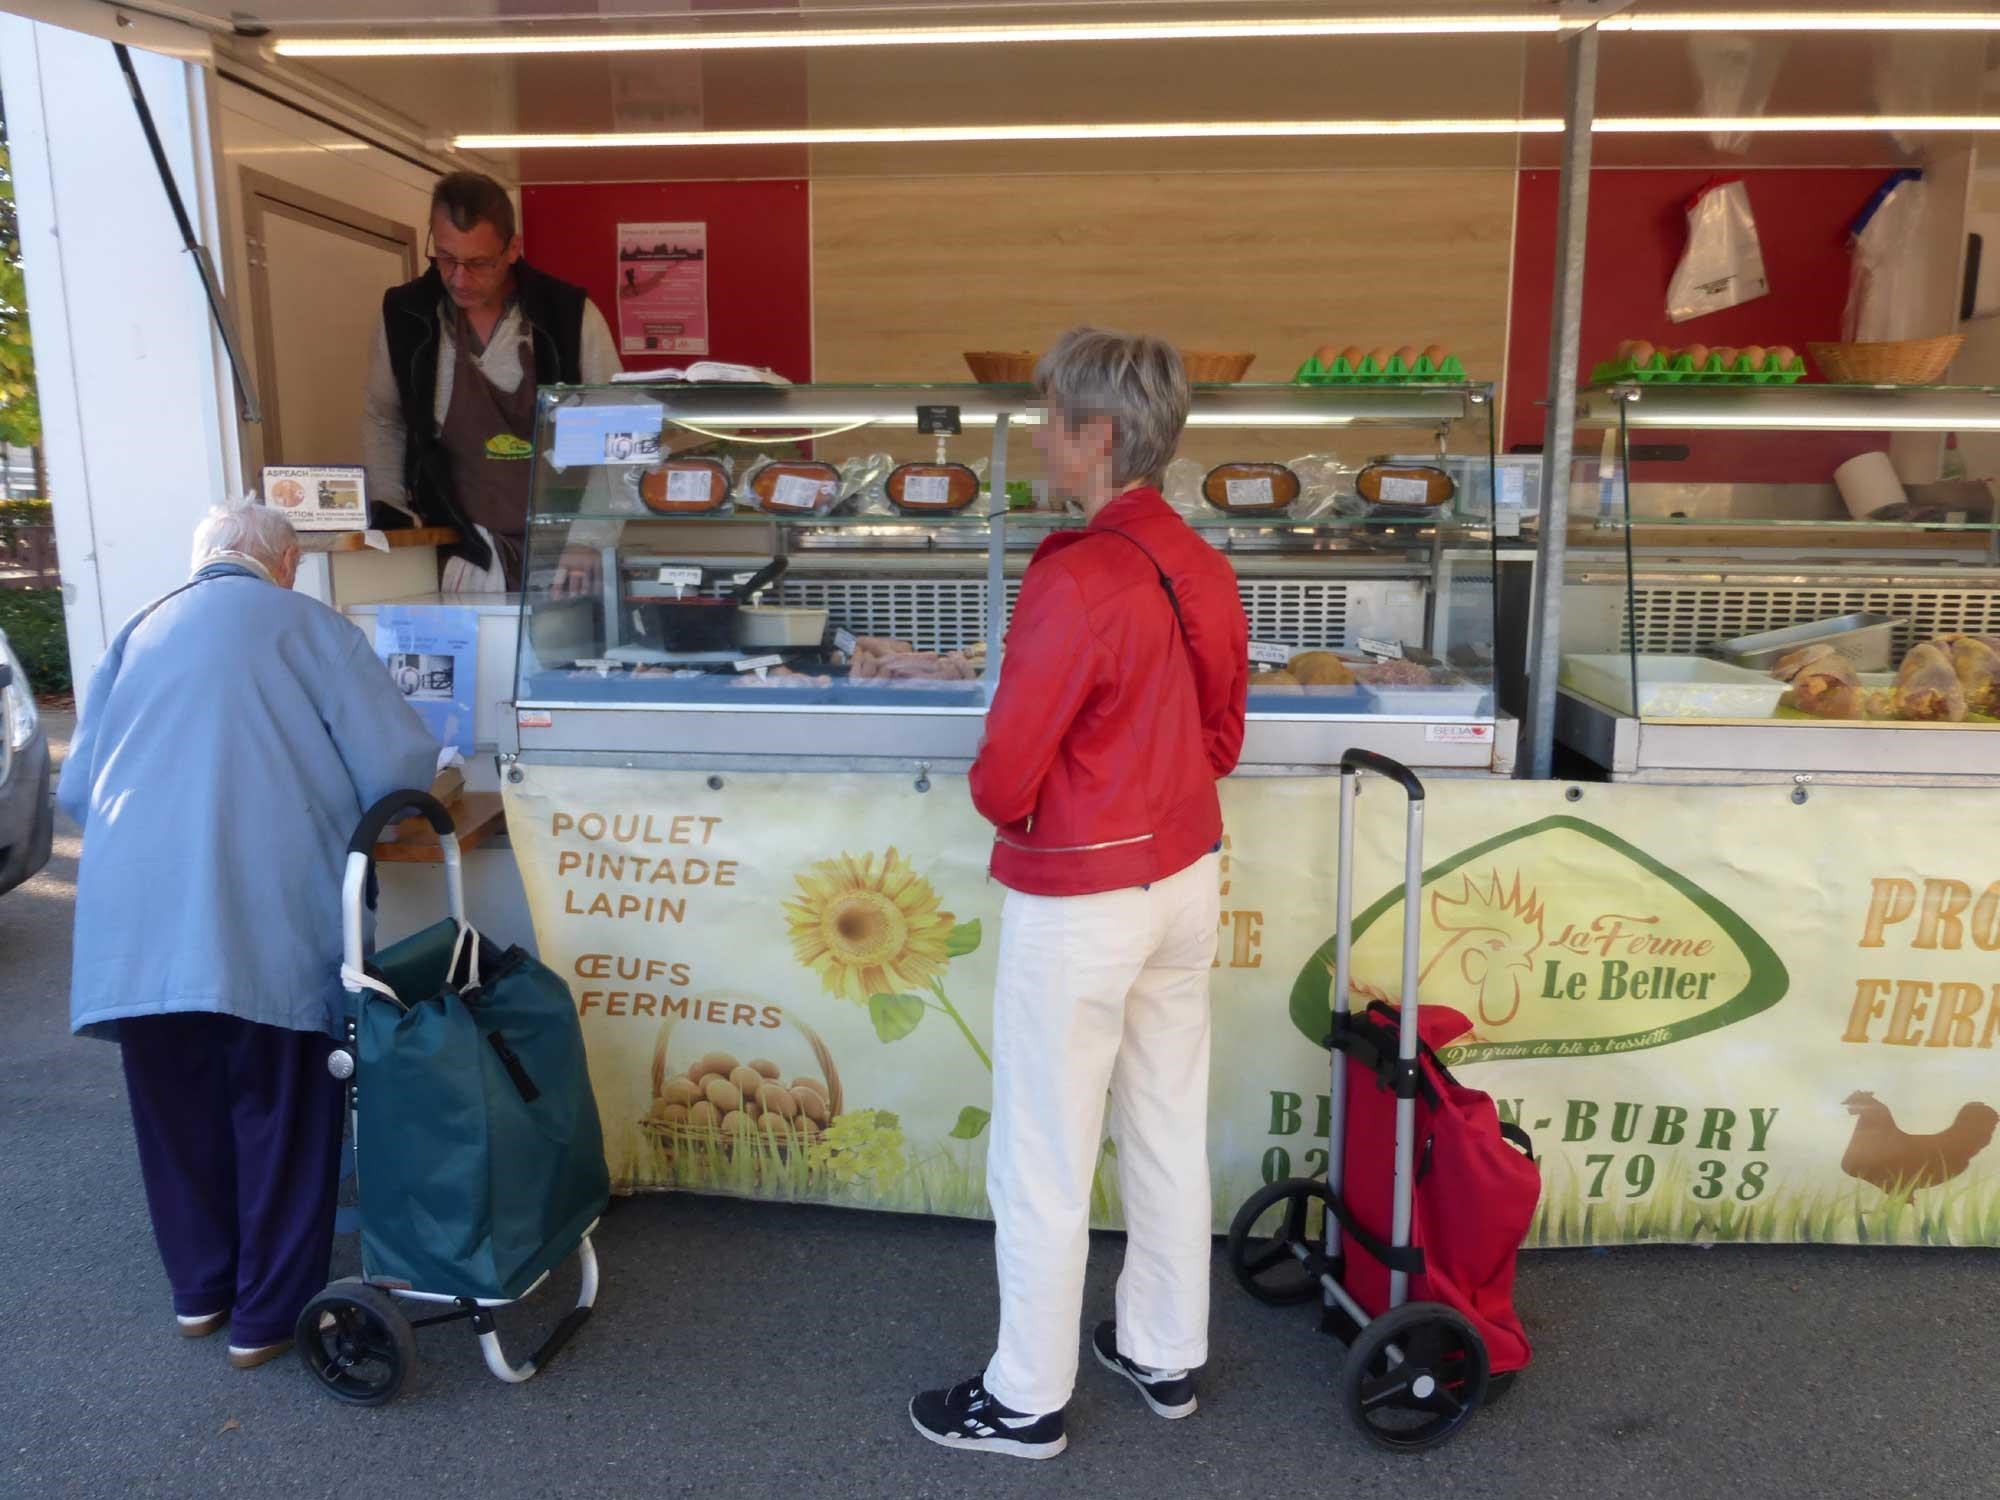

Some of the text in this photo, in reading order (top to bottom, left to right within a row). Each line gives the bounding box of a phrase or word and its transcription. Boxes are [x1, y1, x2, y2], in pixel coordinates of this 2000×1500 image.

[552, 812, 722, 845] POULET
[558, 851, 738, 886] PINTADE
[565, 889, 687, 923] LAPIN
[1548, 914, 1715, 957] La Ferme
[574, 953, 691, 986] ŒUFS
[1540, 960, 1717, 1000] Le Beller
[579, 991, 782, 1028] FERMIERS
[1447, 1046, 1478, 1066] Du
[1481, 1044, 1528, 1060] grain
[1532, 1042, 1553, 1055] de
[1585, 1154, 1656, 1198] 79
[1692, 1160, 1769, 1201] 38
